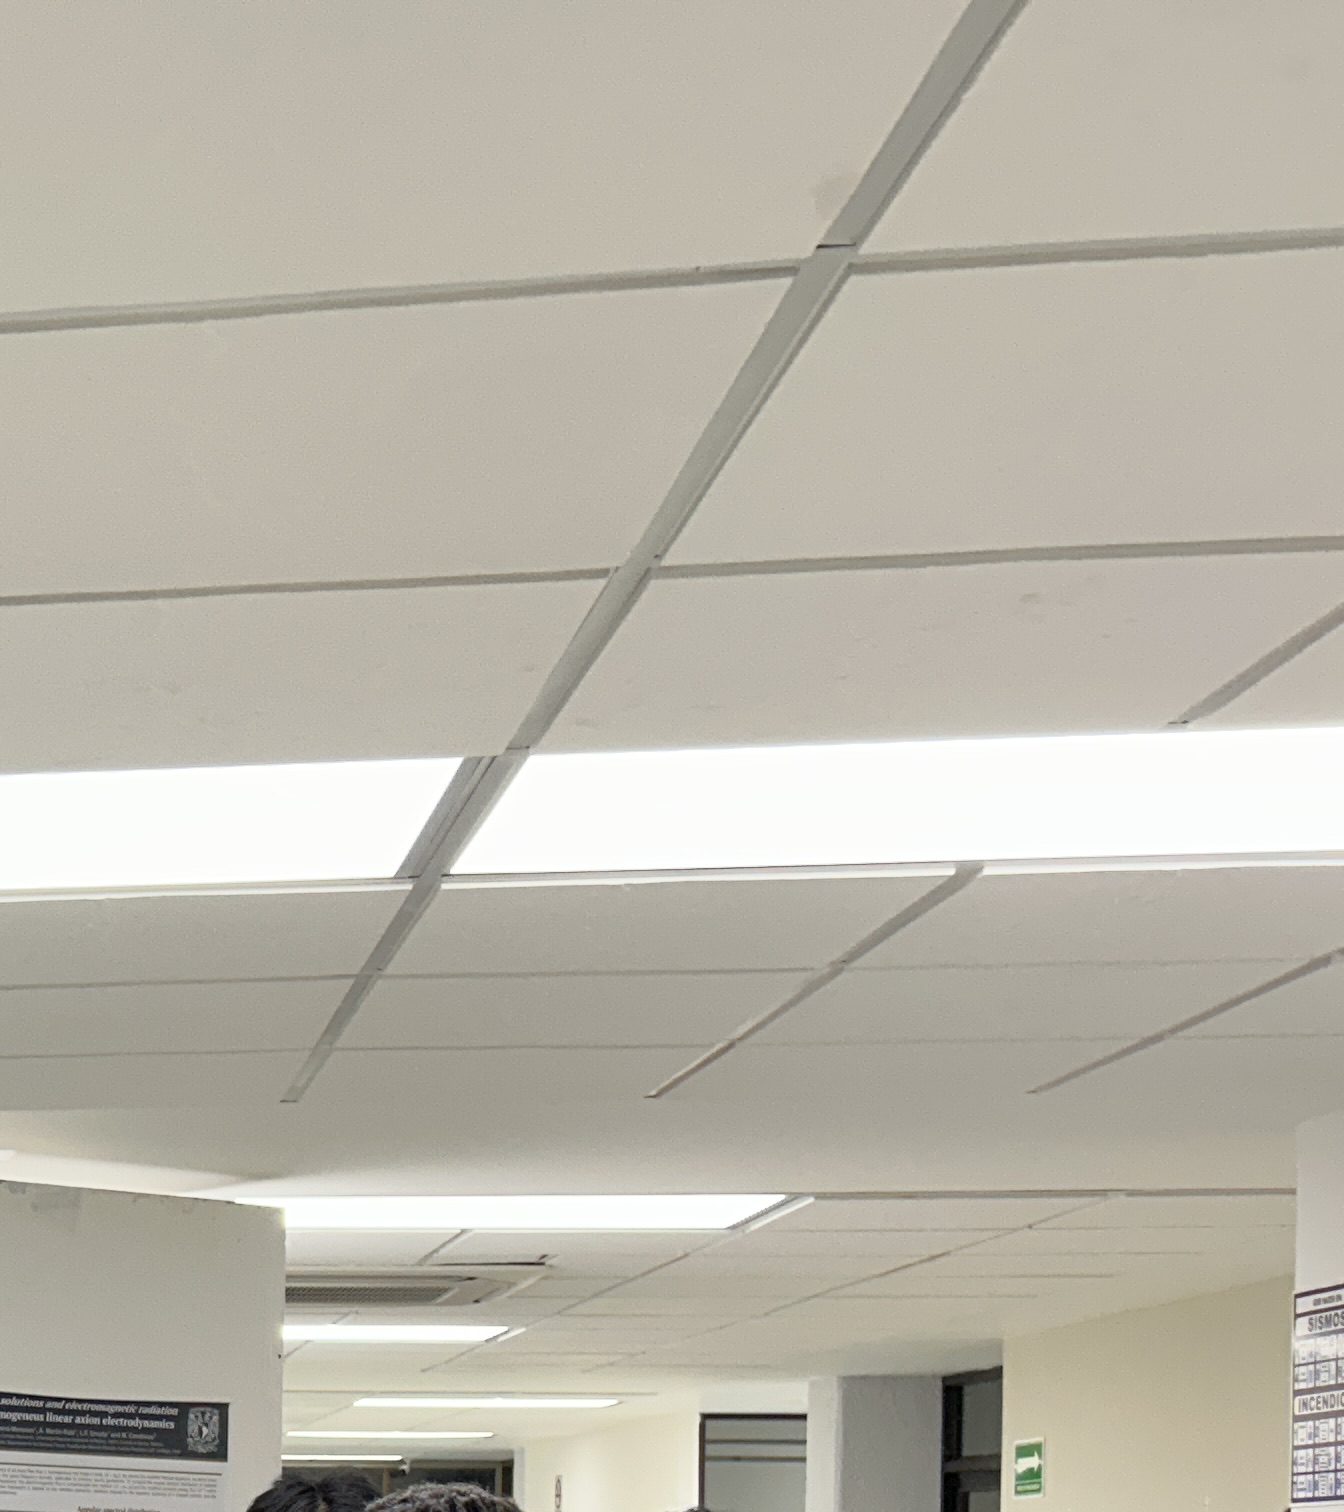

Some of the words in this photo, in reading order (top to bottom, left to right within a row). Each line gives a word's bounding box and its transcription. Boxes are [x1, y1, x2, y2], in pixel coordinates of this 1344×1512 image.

[0, 1396, 43, 1408] solutions
[45, 1399, 63, 1409] and
[65, 1401, 138, 1413] electromagnetic
[138, 1406, 179, 1416] radiation
[47, 1412, 73, 1423] linear
[75, 1414, 100, 1425] axion
[102, 1416, 175, 1429] electrodynamics
